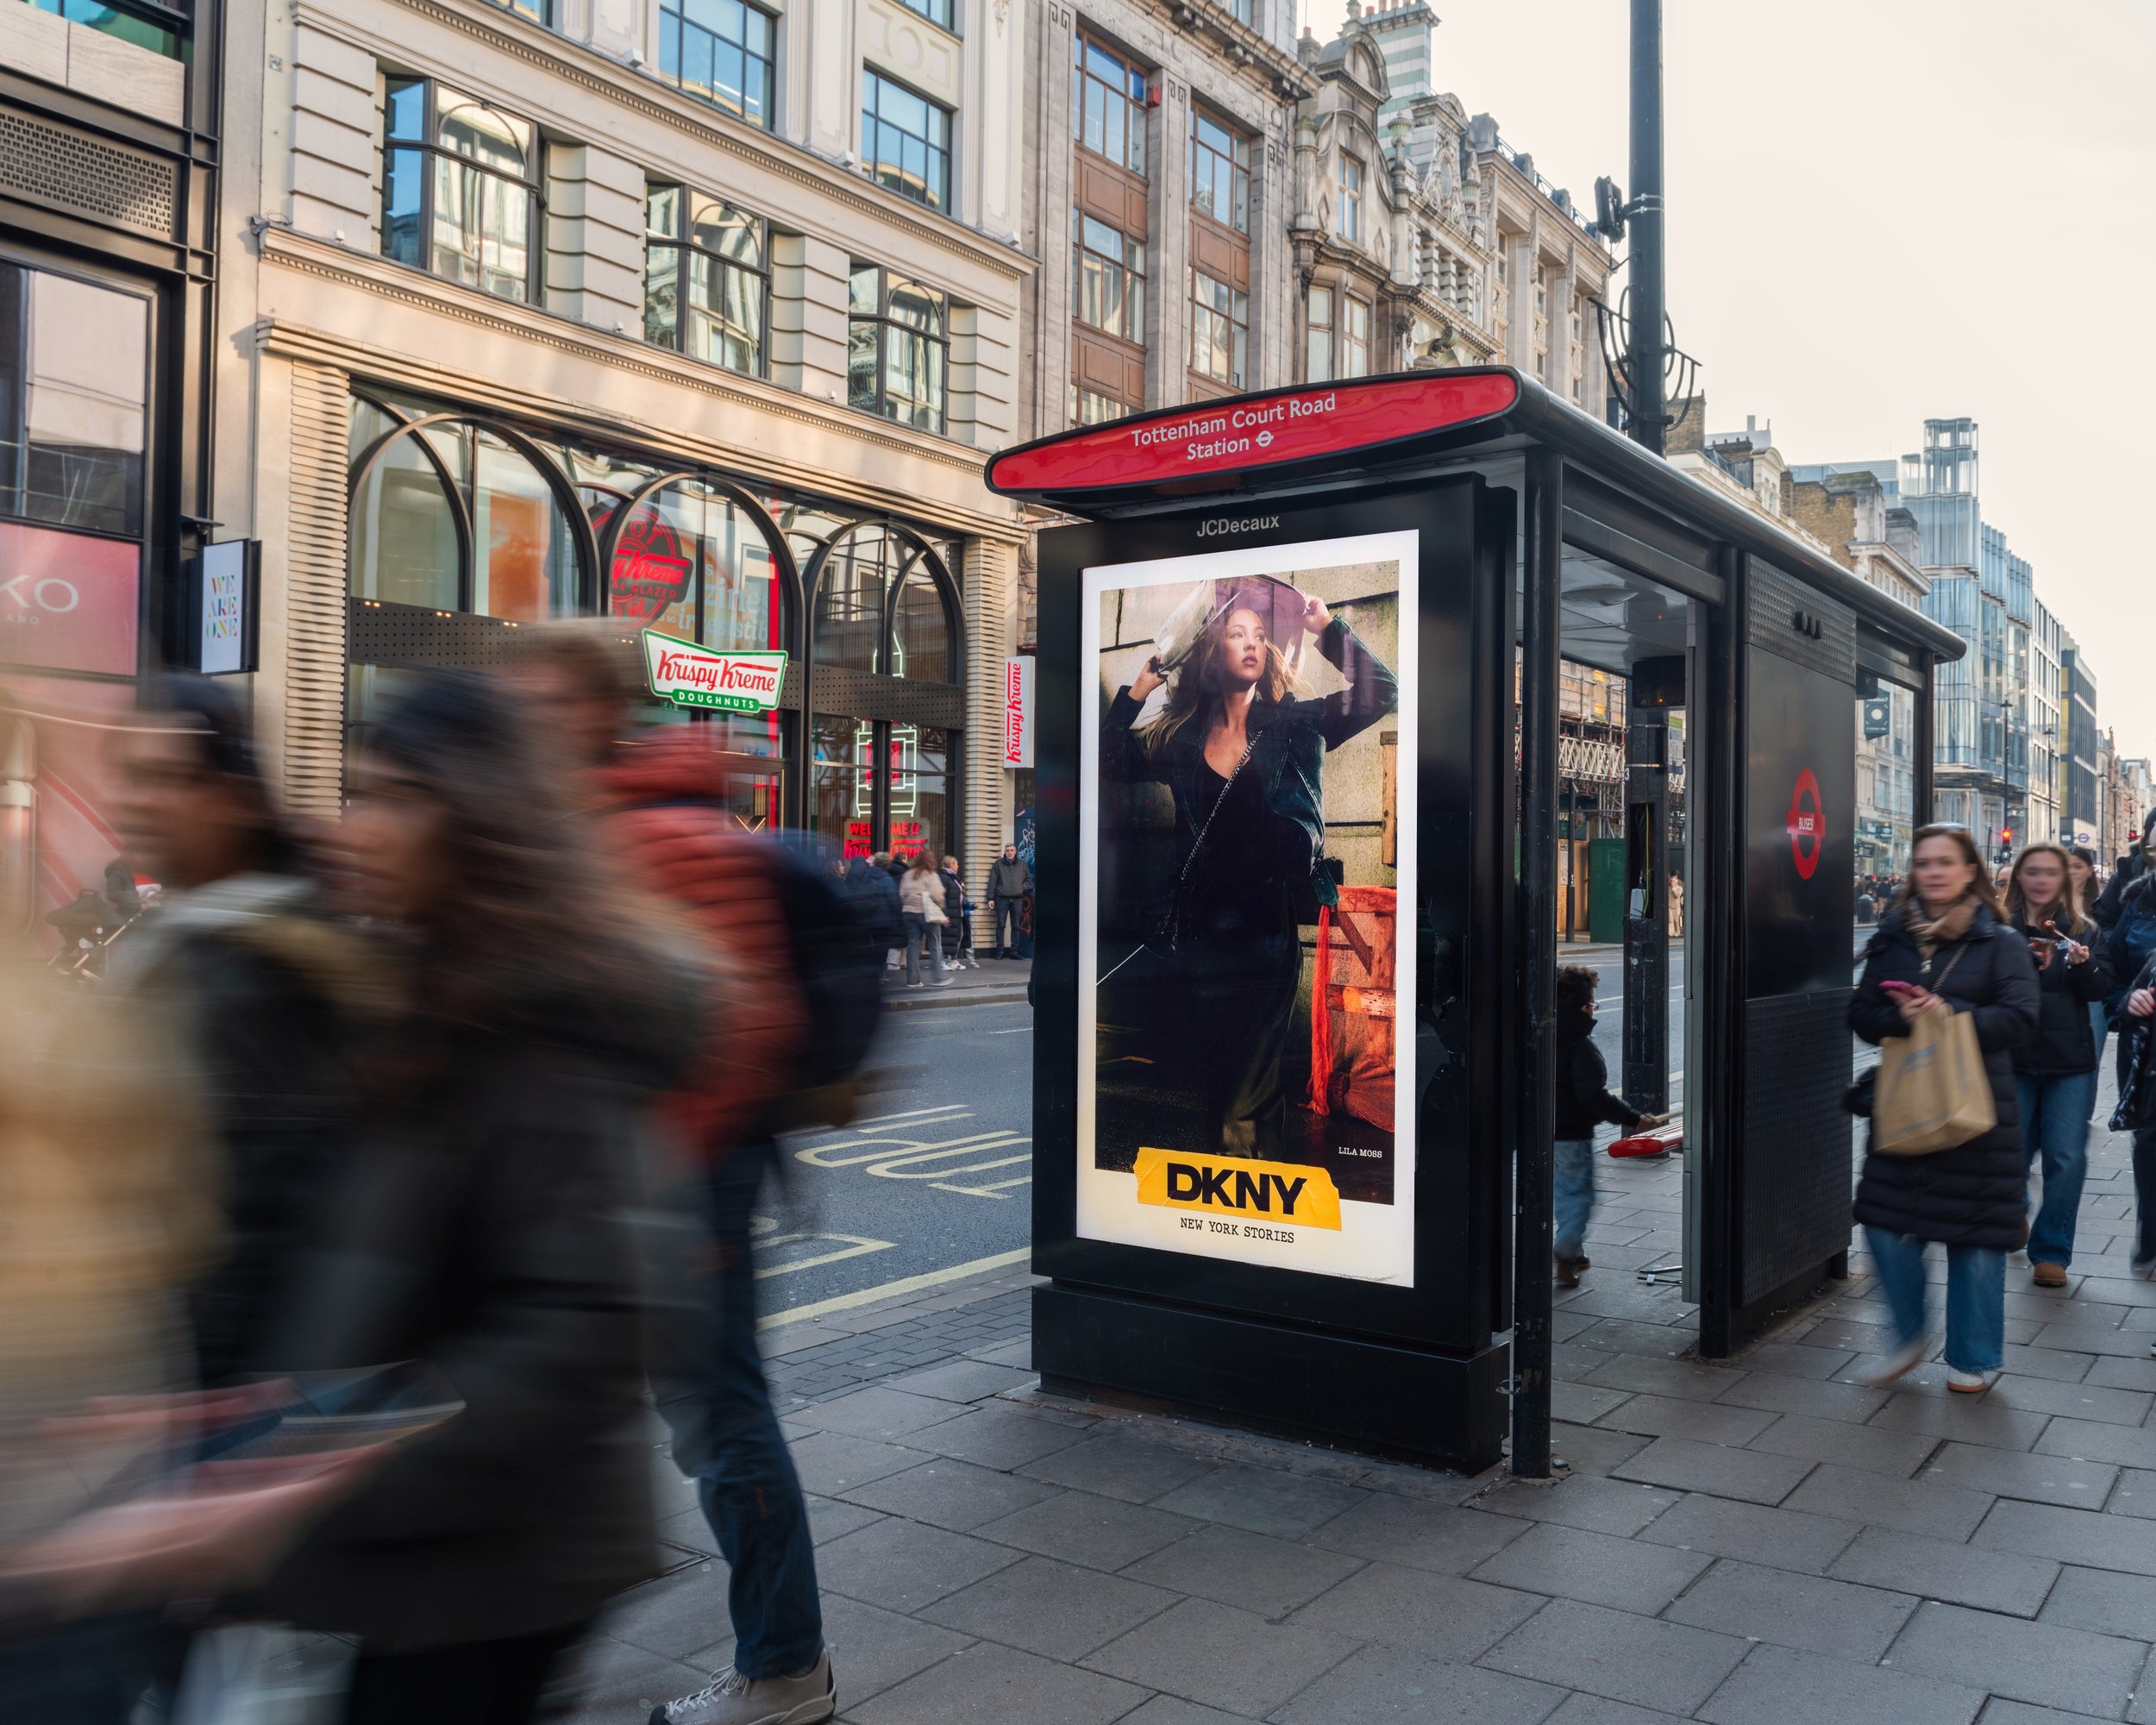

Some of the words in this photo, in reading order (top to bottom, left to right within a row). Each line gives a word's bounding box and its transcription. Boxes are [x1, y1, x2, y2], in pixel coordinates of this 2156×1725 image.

[1131, 419, 1226, 447] Tottenham
[1232, 405, 1285, 428] Court
[1289, 393, 1337, 418] Road
[1187, 437, 1250, 461] Station
[1196, 516, 1280, 537] JCDecaux
[209, 574, 235, 596] WE
[207, 596, 237, 619] ARE
[205, 618, 238, 639] ONE
[656, 649, 721, 691] Krispy
[719, 659, 778, 692] Kreme
[1007, 662, 1022, 712] Kreme
[679, 692, 754, 709] DOUGHNUTS
[1006, 711, 1024, 763] Krispy
[1798, 817, 1814, 831] BUSES
[1338, 1146, 1357, 1156] LILA
[1359, 1148, 1382, 1158] MOSS
[1167, 1162, 1307, 1215] DKNY
[1180, 1217, 1203, 1232] NEW
[1208, 1220, 1239, 1237] YORK
[1244, 1226, 1295, 1244] STORIES
